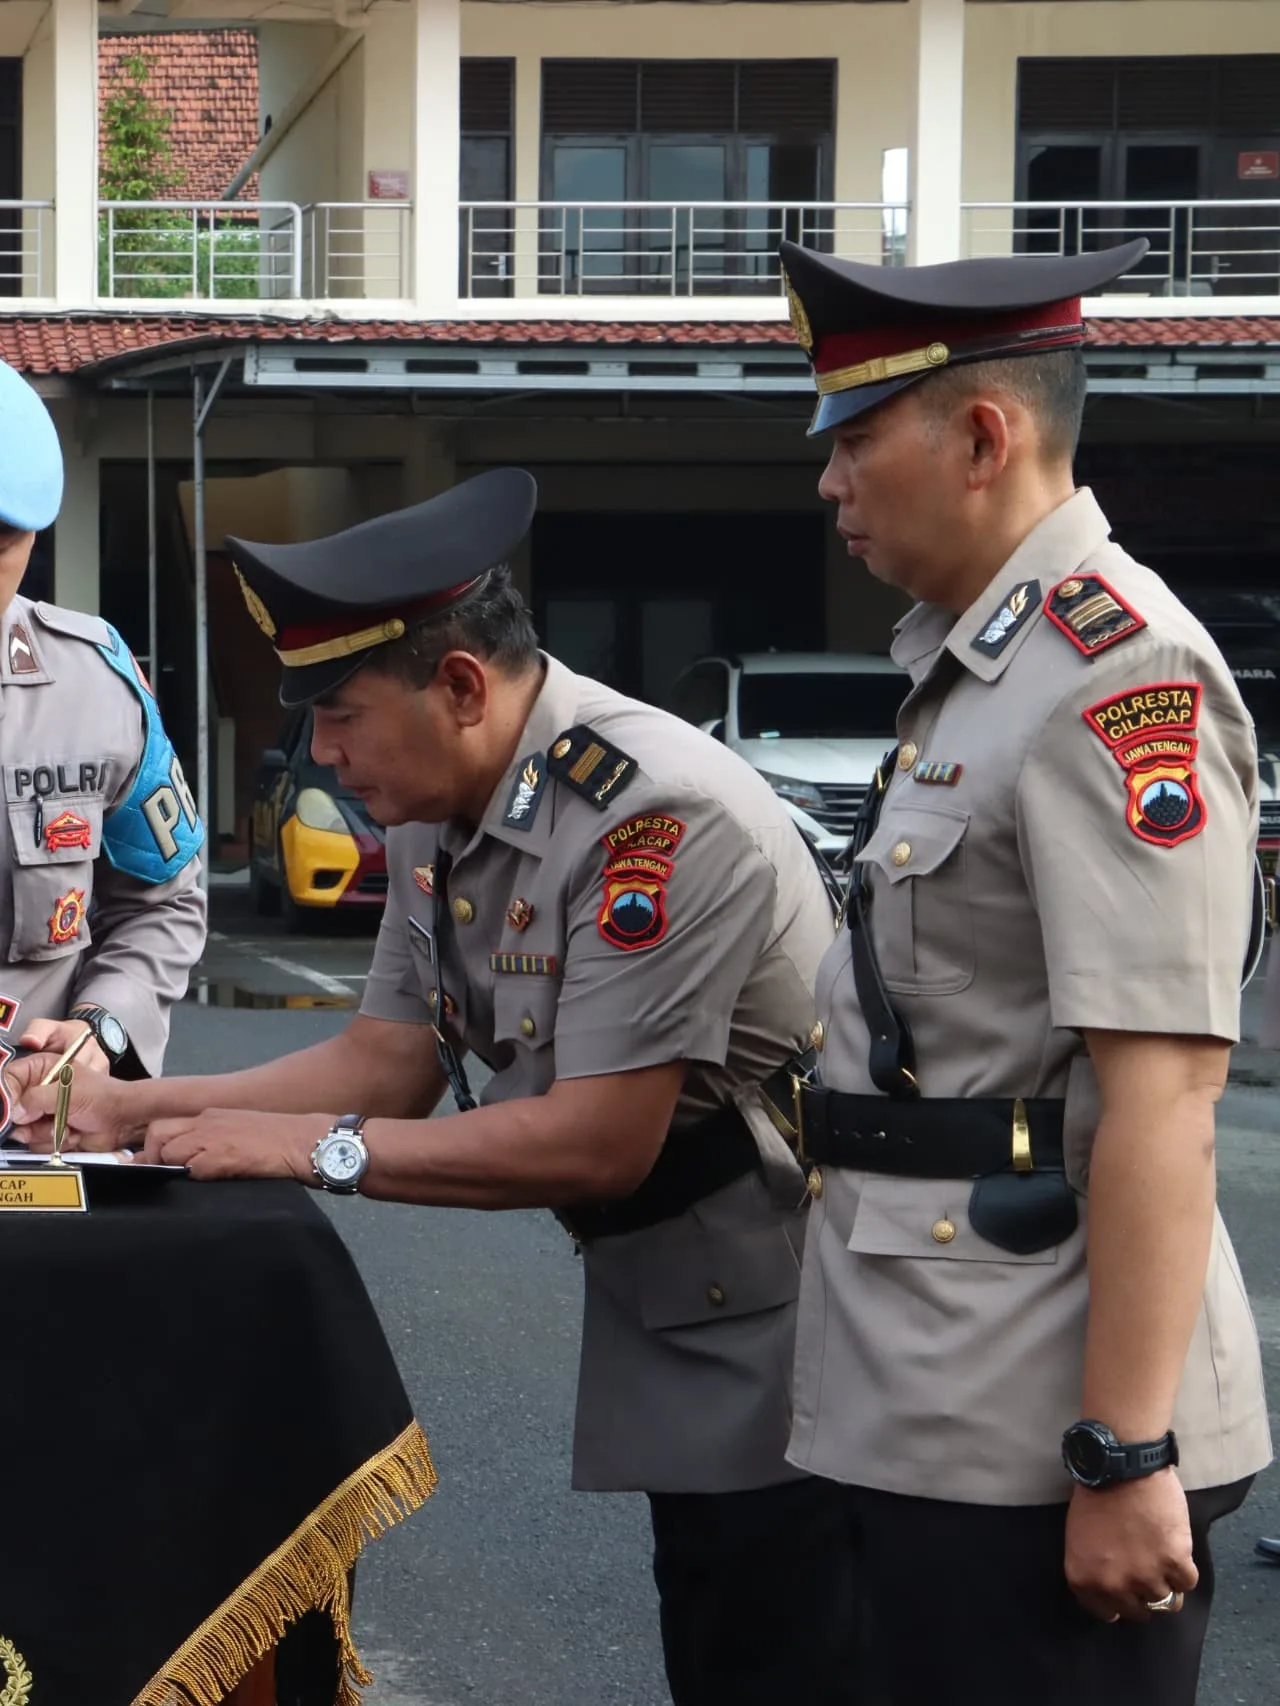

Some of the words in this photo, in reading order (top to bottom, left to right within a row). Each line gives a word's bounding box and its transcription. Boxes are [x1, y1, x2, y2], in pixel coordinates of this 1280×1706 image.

[1094, 690, 1193, 729] POLRESTA
[1108, 708, 1192, 740] CILACAP
[1125, 744, 1151, 761] JAWA
[1151, 741, 1191, 754] TENGAH
[14, 761, 108, 796] POLRI
[607, 817, 681, 848] POLRESTA
[633, 858, 667, 875] TENGAH
